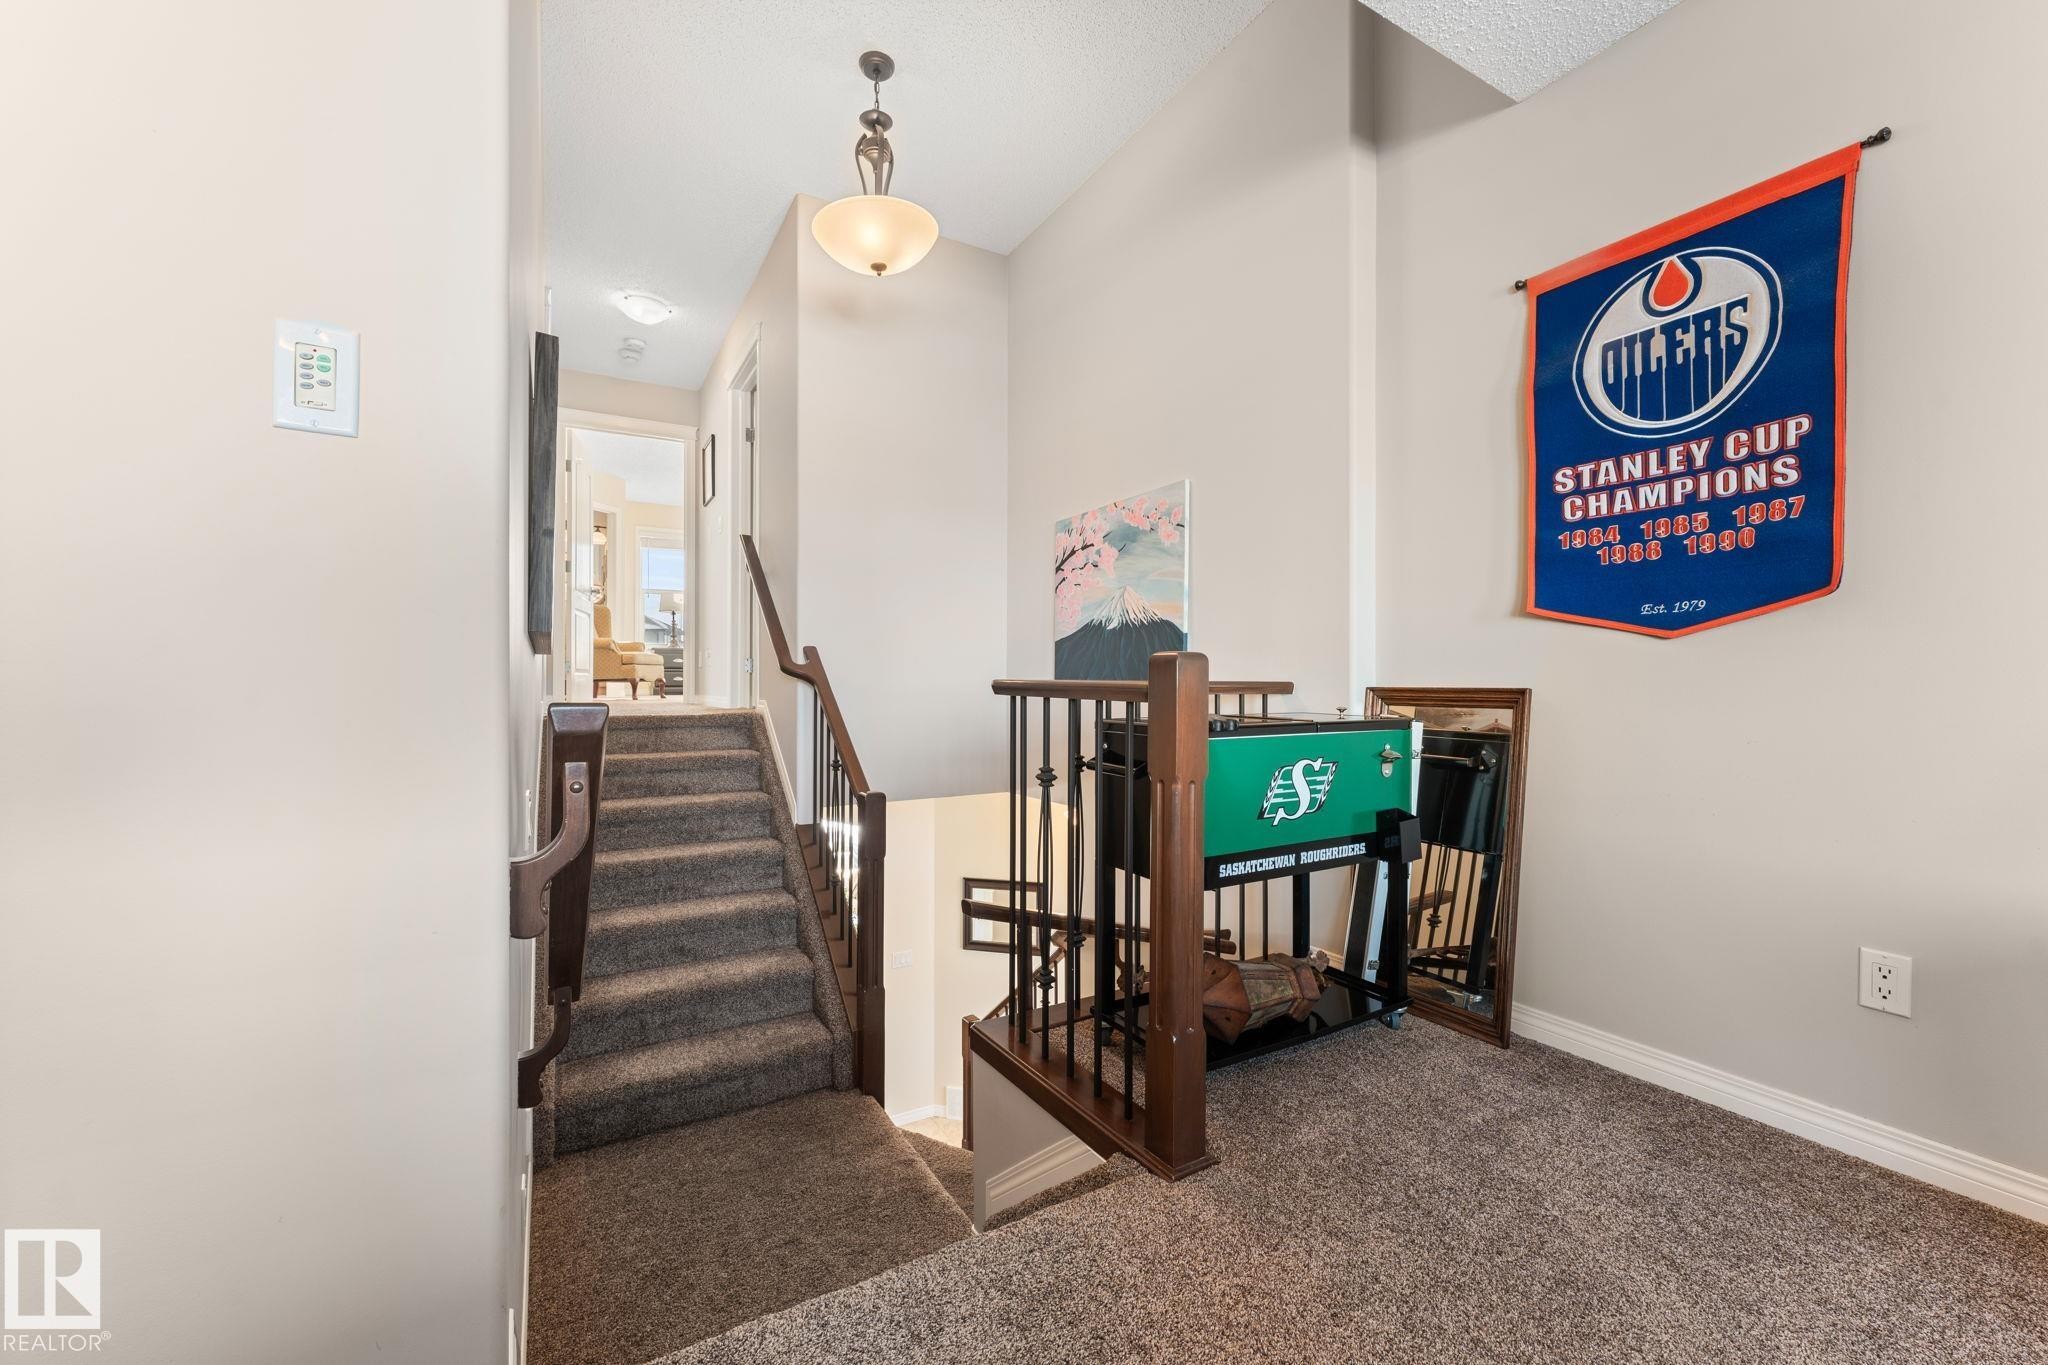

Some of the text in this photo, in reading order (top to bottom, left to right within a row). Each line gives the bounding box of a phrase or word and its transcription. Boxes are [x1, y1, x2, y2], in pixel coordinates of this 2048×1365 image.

[1600, 294, 1752, 421] OILERS
[1553, 414, 1813, 494] STANLEY CUP
[1562, 456, 1801, 522] CHAMPIONS
[1559, 495, 1805, 549] 1984 1985 1987
[1597, 527, 1755, 565] 1988 1990
[1640, 599, 1706, 615] Est. 1979
[1219, 854, 1295, 878] SASKATCHEWAN
